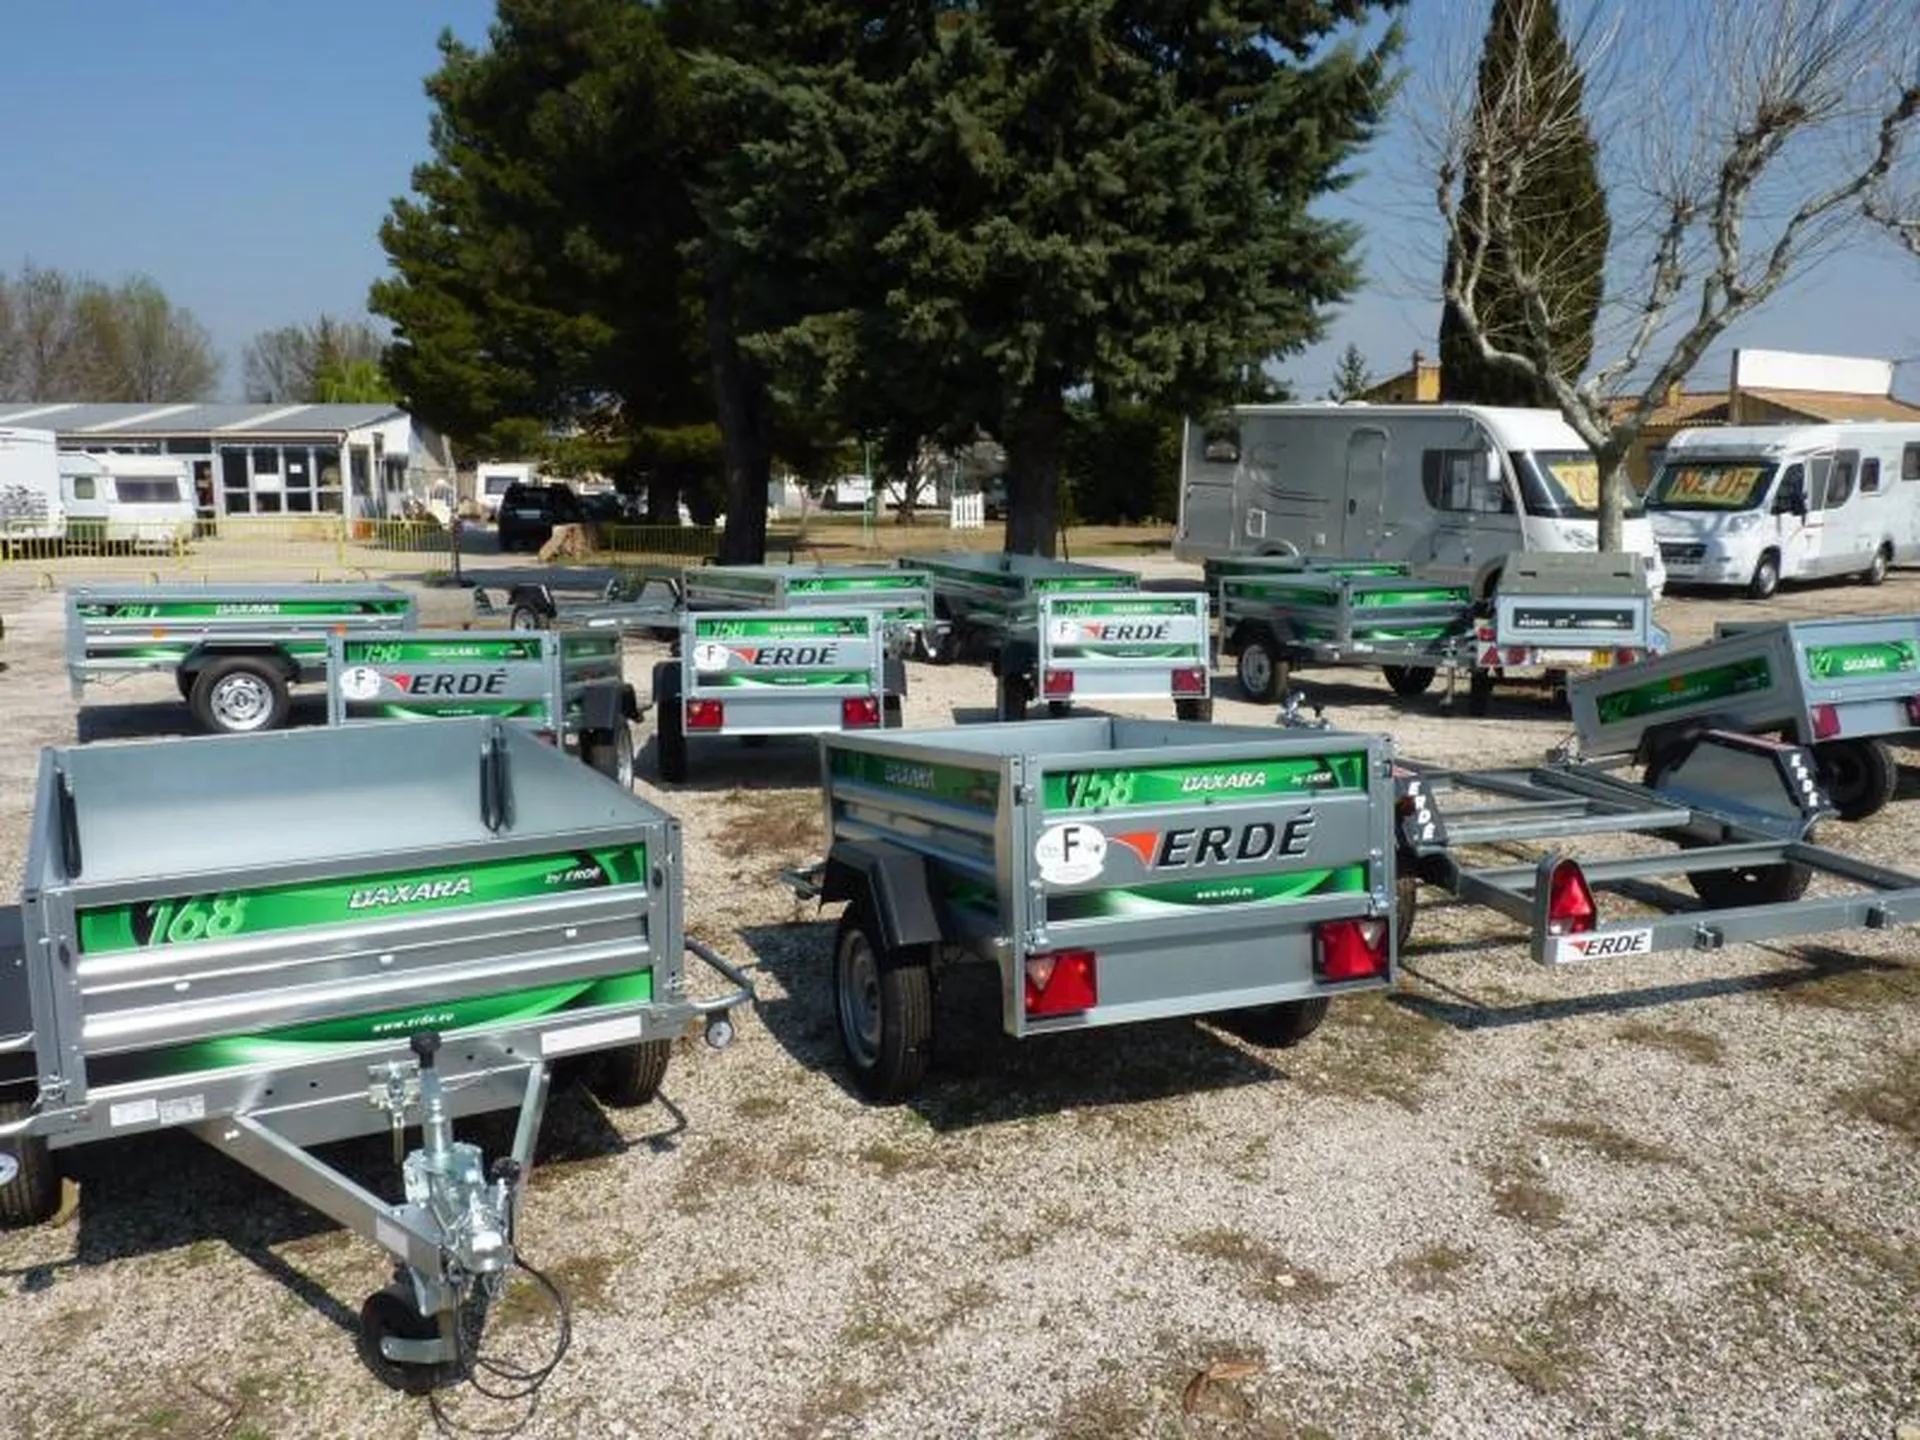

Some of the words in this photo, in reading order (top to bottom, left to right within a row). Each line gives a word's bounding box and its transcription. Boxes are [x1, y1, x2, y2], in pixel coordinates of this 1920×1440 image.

[1101, 620, 1171, 641] ERDÉ
[705, 645, 716, 662] F
[753, 642, 839, 666] ERDÉ
[410, 668, 507, 695] ERDÉ
[1072, 767, 1135, 807] 158
[1181, 771, 1268, 791] DAXARA
[1063, 827, 1080, 862] F
[1157, 807, 1319, 869] ERDÉ
[348, 877, 474, 909] DAXARA
[146, 893, 249, 947] 168
[1584, 931, 1648, 957] ERDÉ
